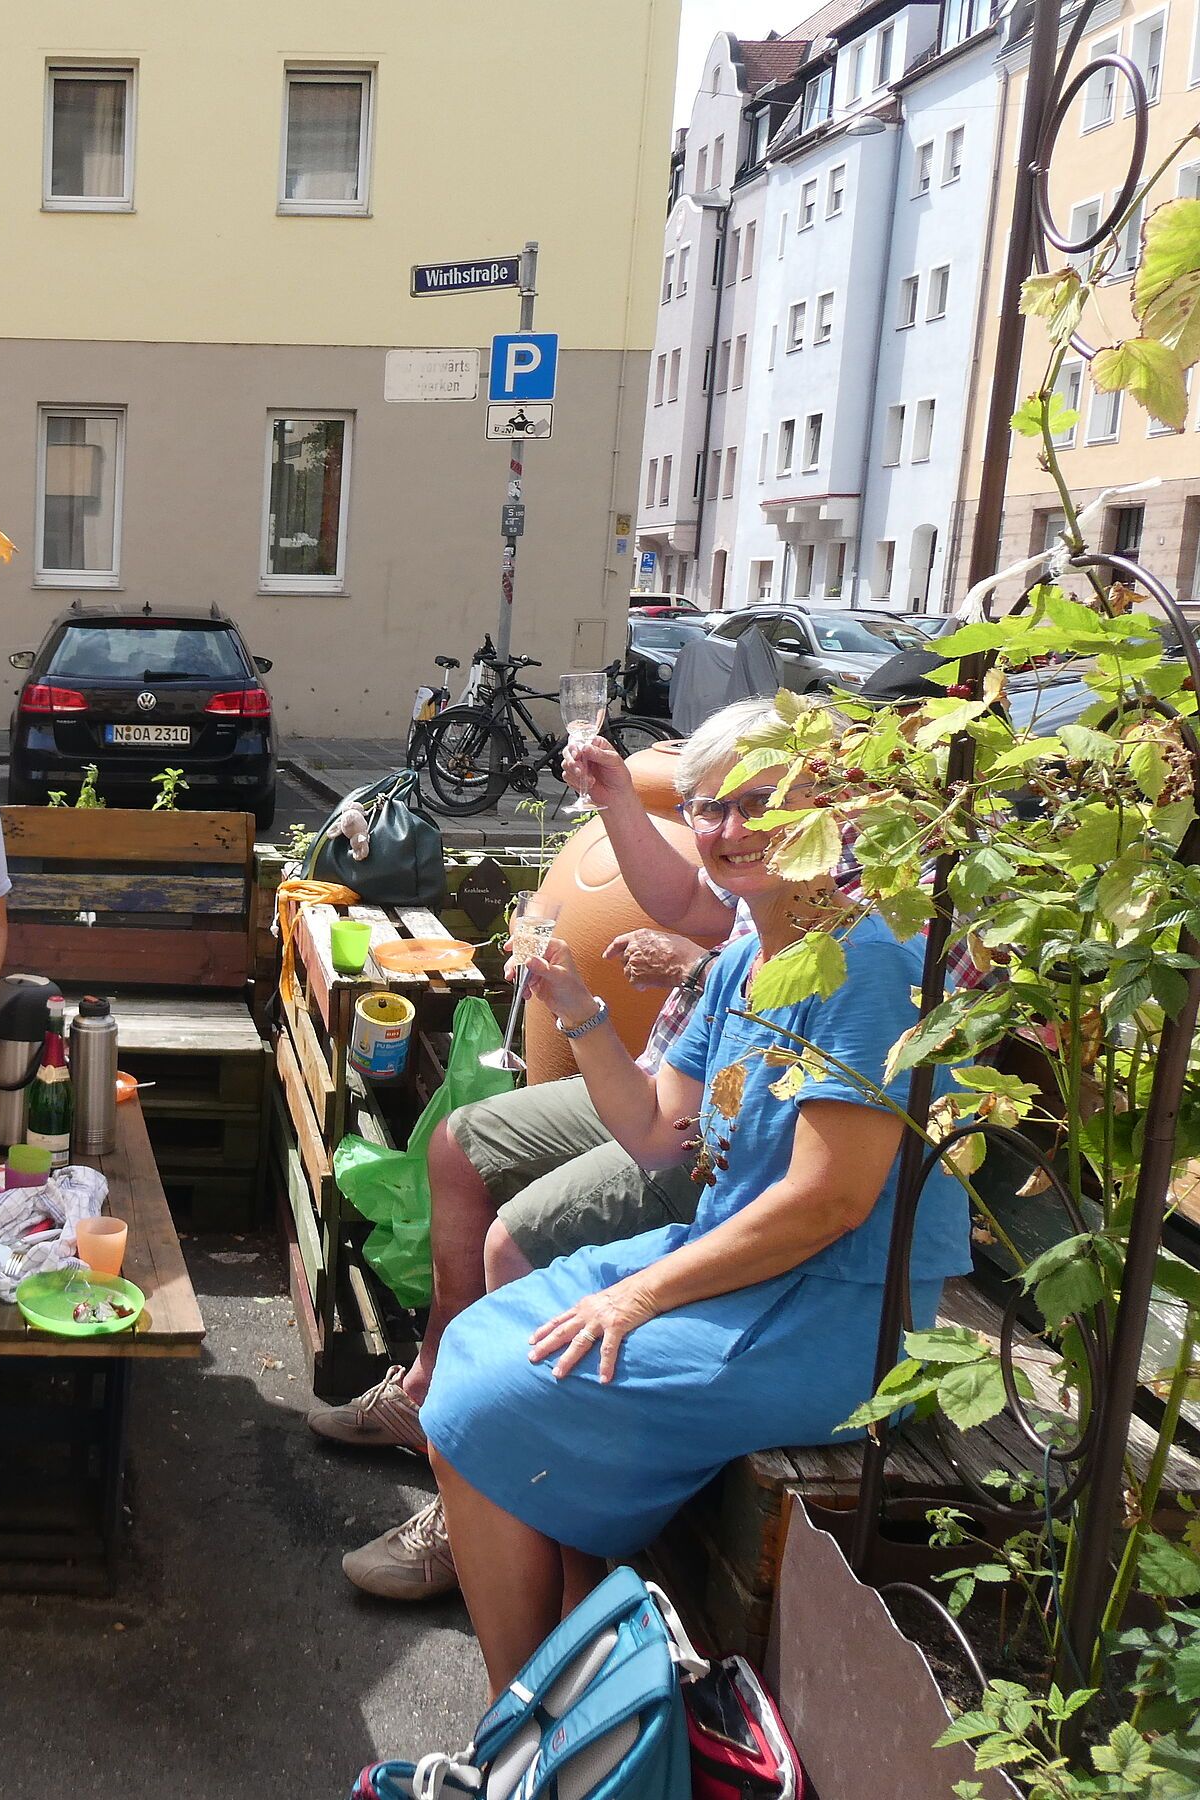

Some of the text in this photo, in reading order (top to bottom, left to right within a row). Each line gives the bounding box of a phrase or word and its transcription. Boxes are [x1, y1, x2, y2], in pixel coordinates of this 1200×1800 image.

[425, 263, 508, 287] Wirthstraße
[421, 359, 471, 373] orwärts
[504, 343, 542, 393] P
[114, 726, 125, 741] N
[154, 727, 189, 742] 2310
